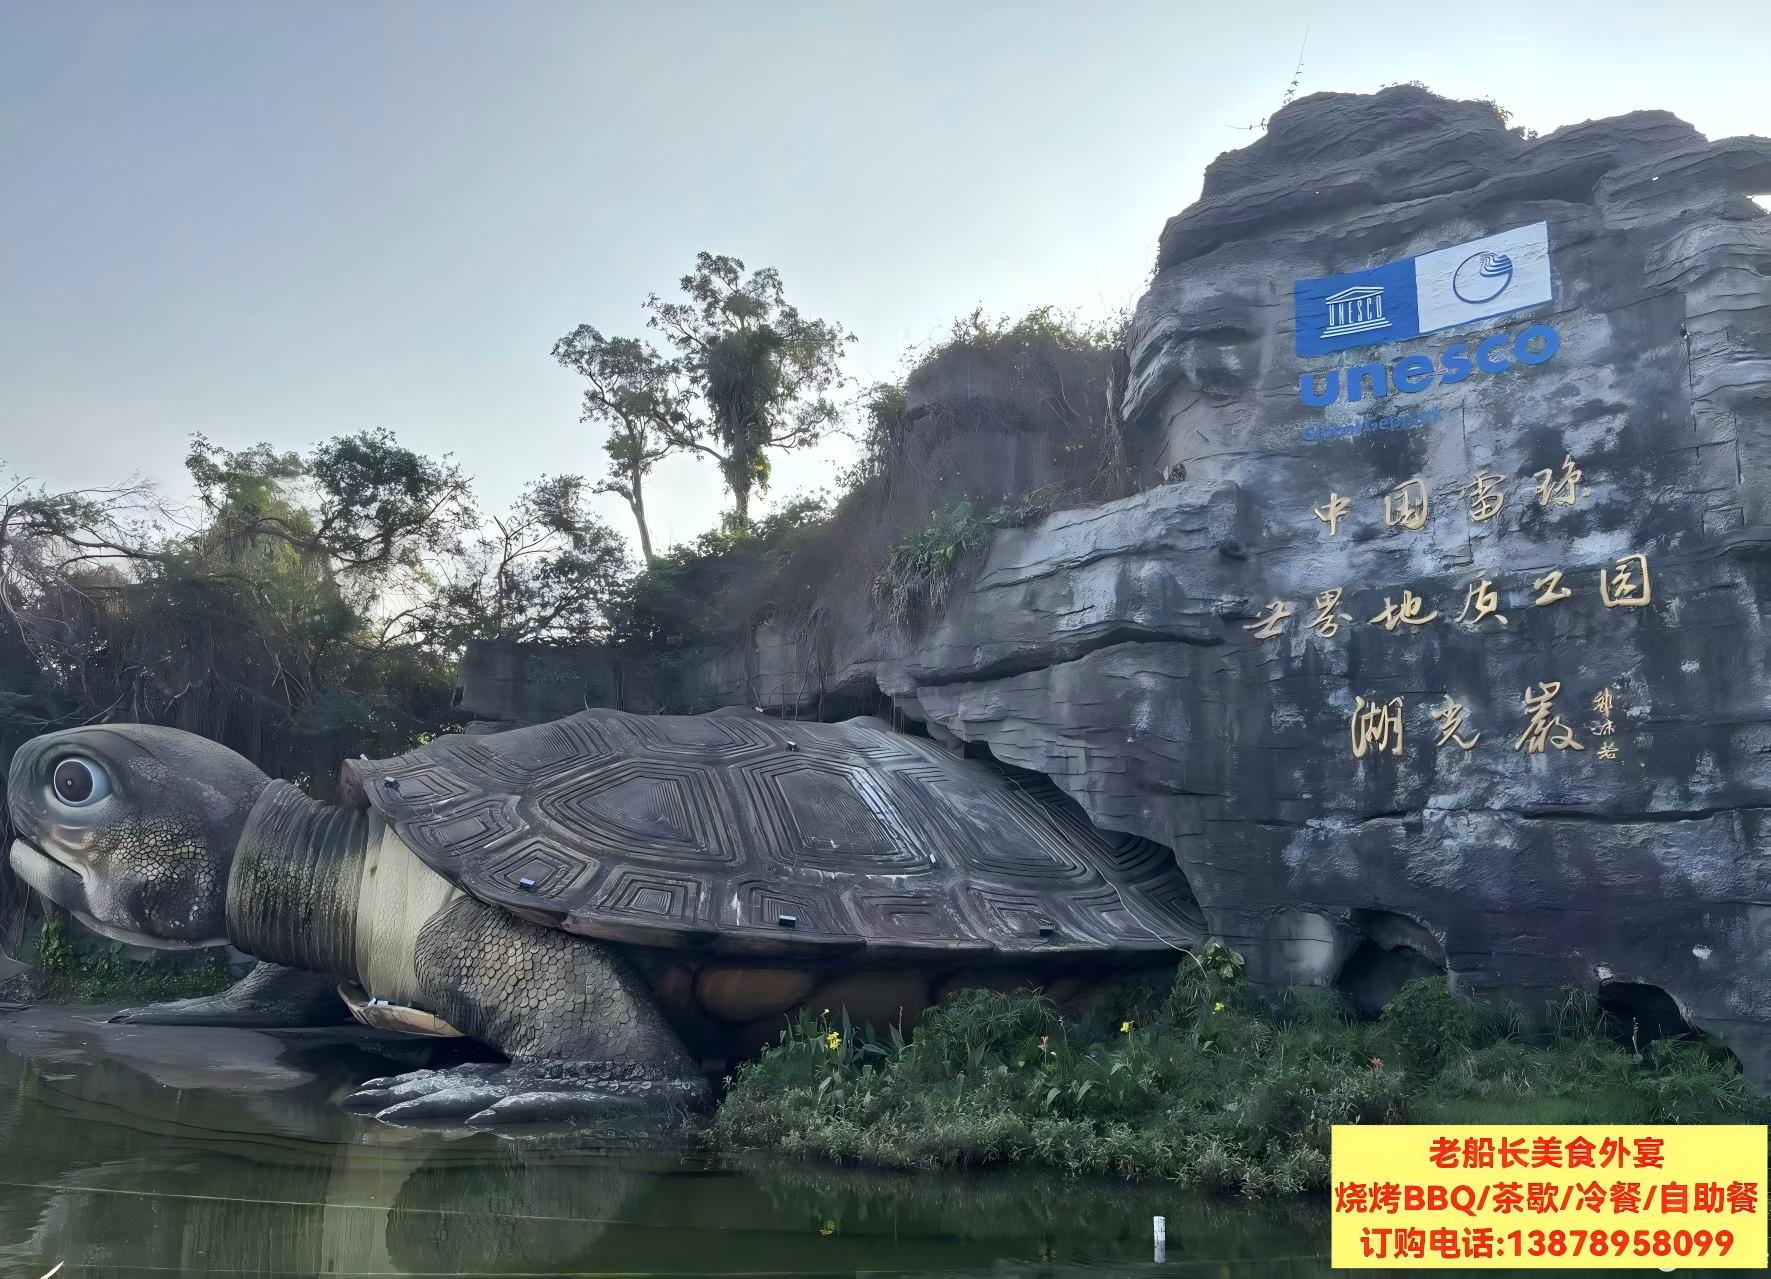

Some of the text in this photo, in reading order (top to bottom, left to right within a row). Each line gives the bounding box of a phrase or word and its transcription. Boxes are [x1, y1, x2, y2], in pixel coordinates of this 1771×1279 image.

[1328, 295, 1383, 327] UNESCO
[1300, 325, 1560, 407] unesco
[1314, 454, 1592, 536] 中国雷琼
